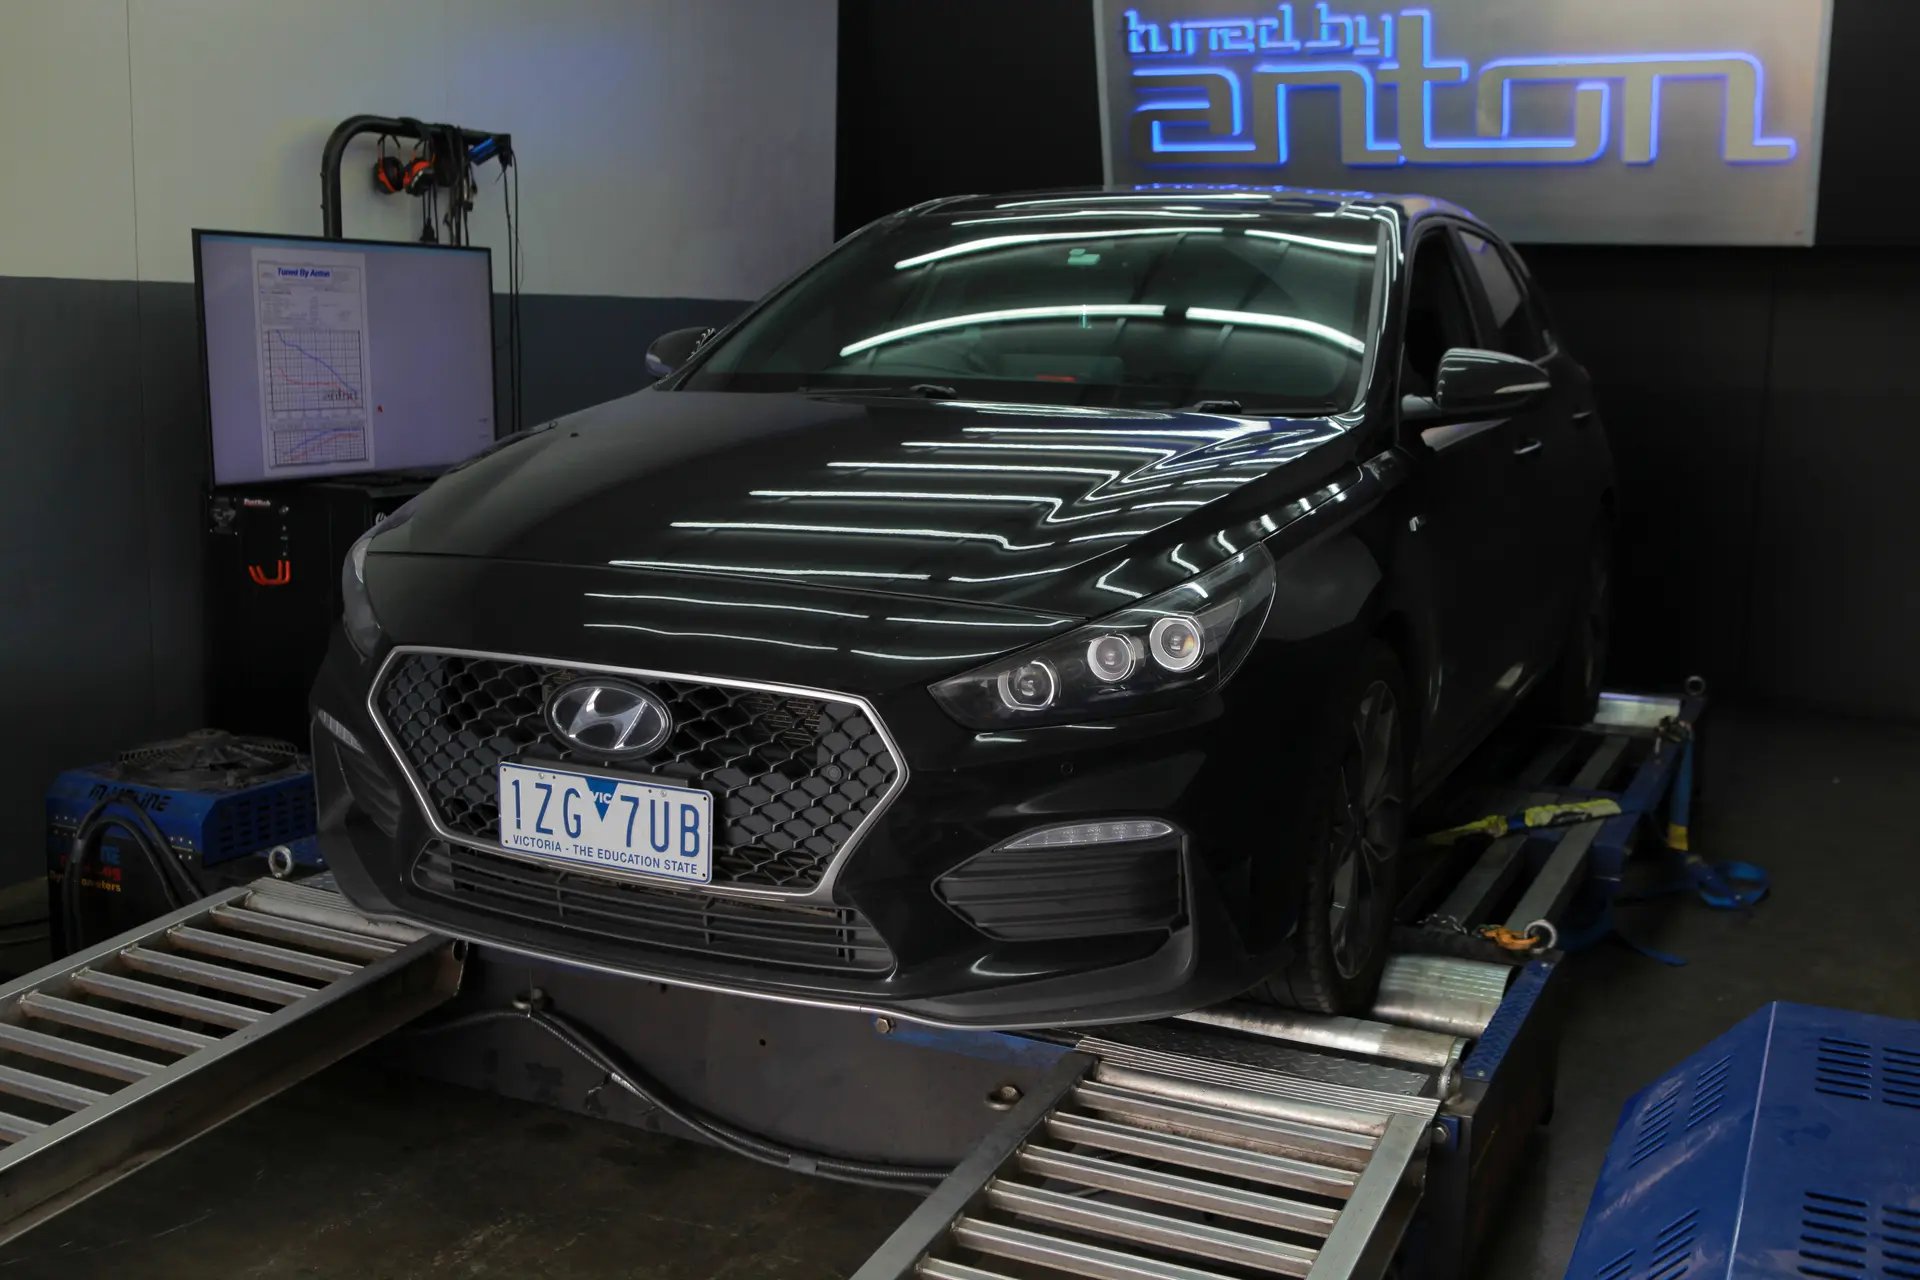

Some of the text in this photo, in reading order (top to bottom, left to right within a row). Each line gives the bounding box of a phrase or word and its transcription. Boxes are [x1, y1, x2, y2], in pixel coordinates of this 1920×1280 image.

[1305, 1, 1396, 60] by
[1130, 8, 1798, 166] anton
[511, 778, 700, 858] 1ZG 7UB
[591, 791, 612, 804] VIC
[513, 834, 562, 852] VICTORIA
[573, 844, 593, 858] THE
[597, 848, 660, 869] EDUCATION
[664, 859, 698, 875] STATE
